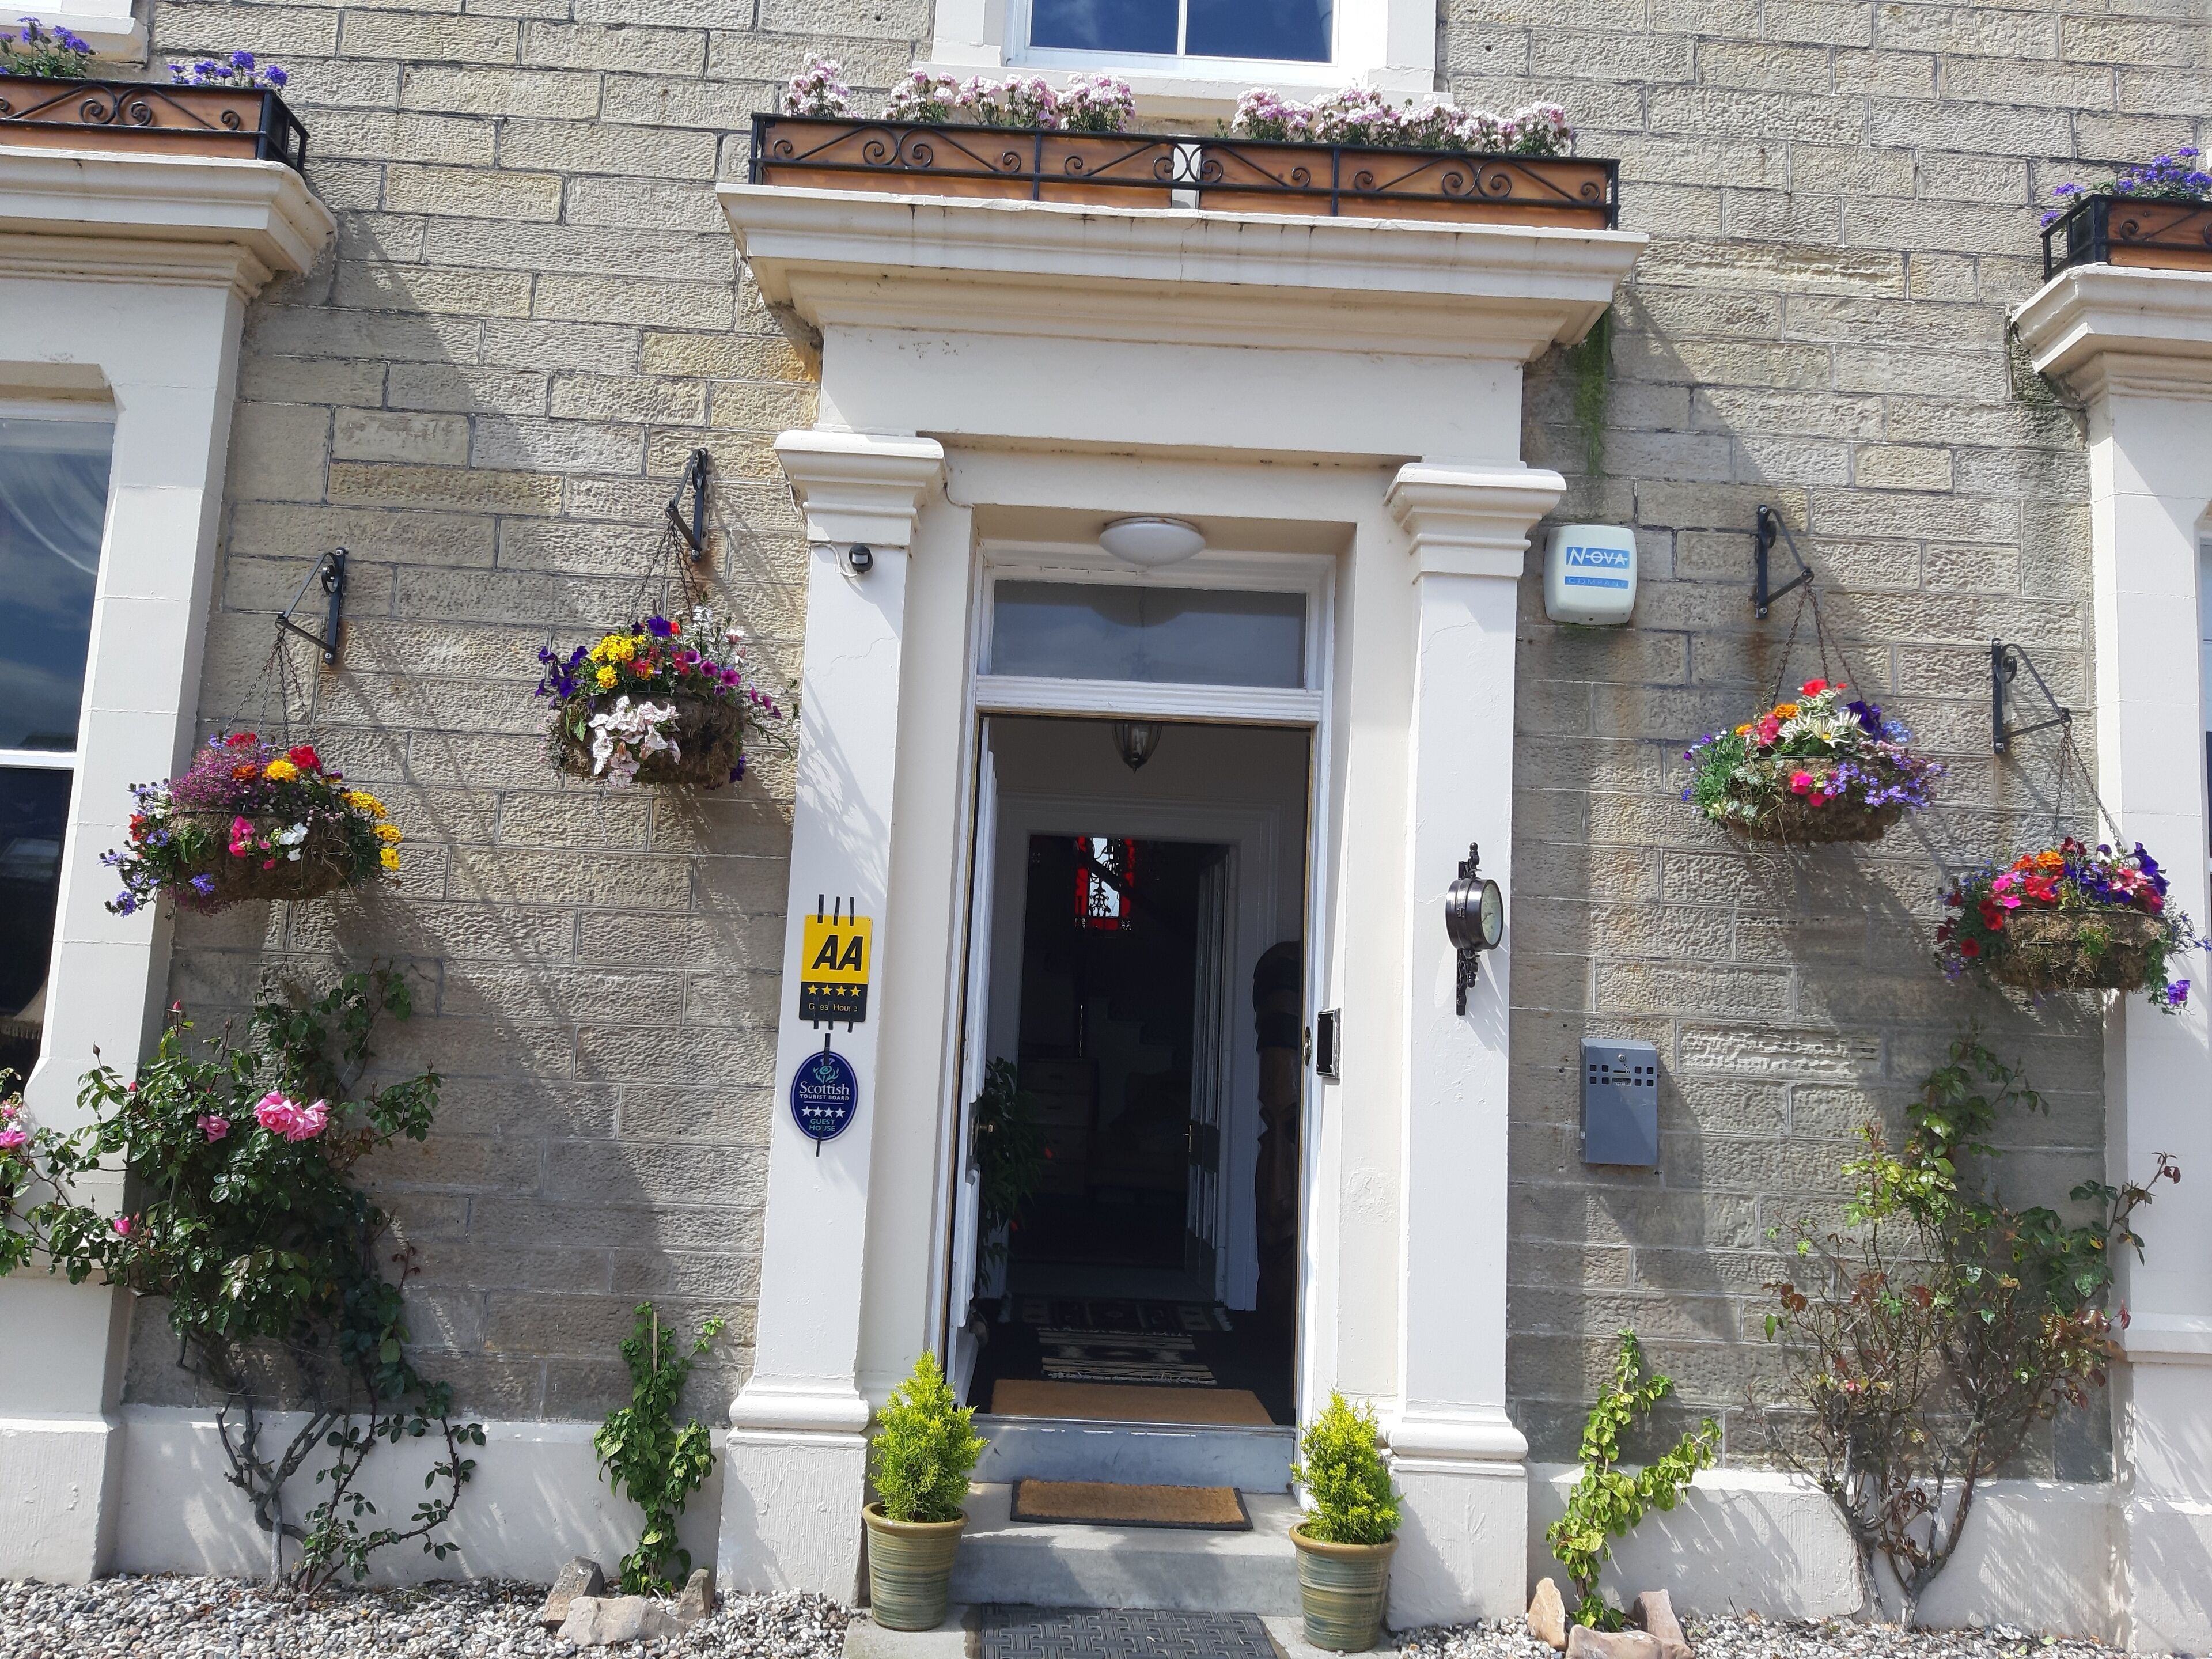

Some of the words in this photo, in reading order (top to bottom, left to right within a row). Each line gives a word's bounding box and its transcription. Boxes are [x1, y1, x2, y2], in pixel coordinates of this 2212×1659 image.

[811, 935, 863, 971] AA
[808, 1003, 831, 1011] Ges
[799, 1081, 850, 1095] Scottish
